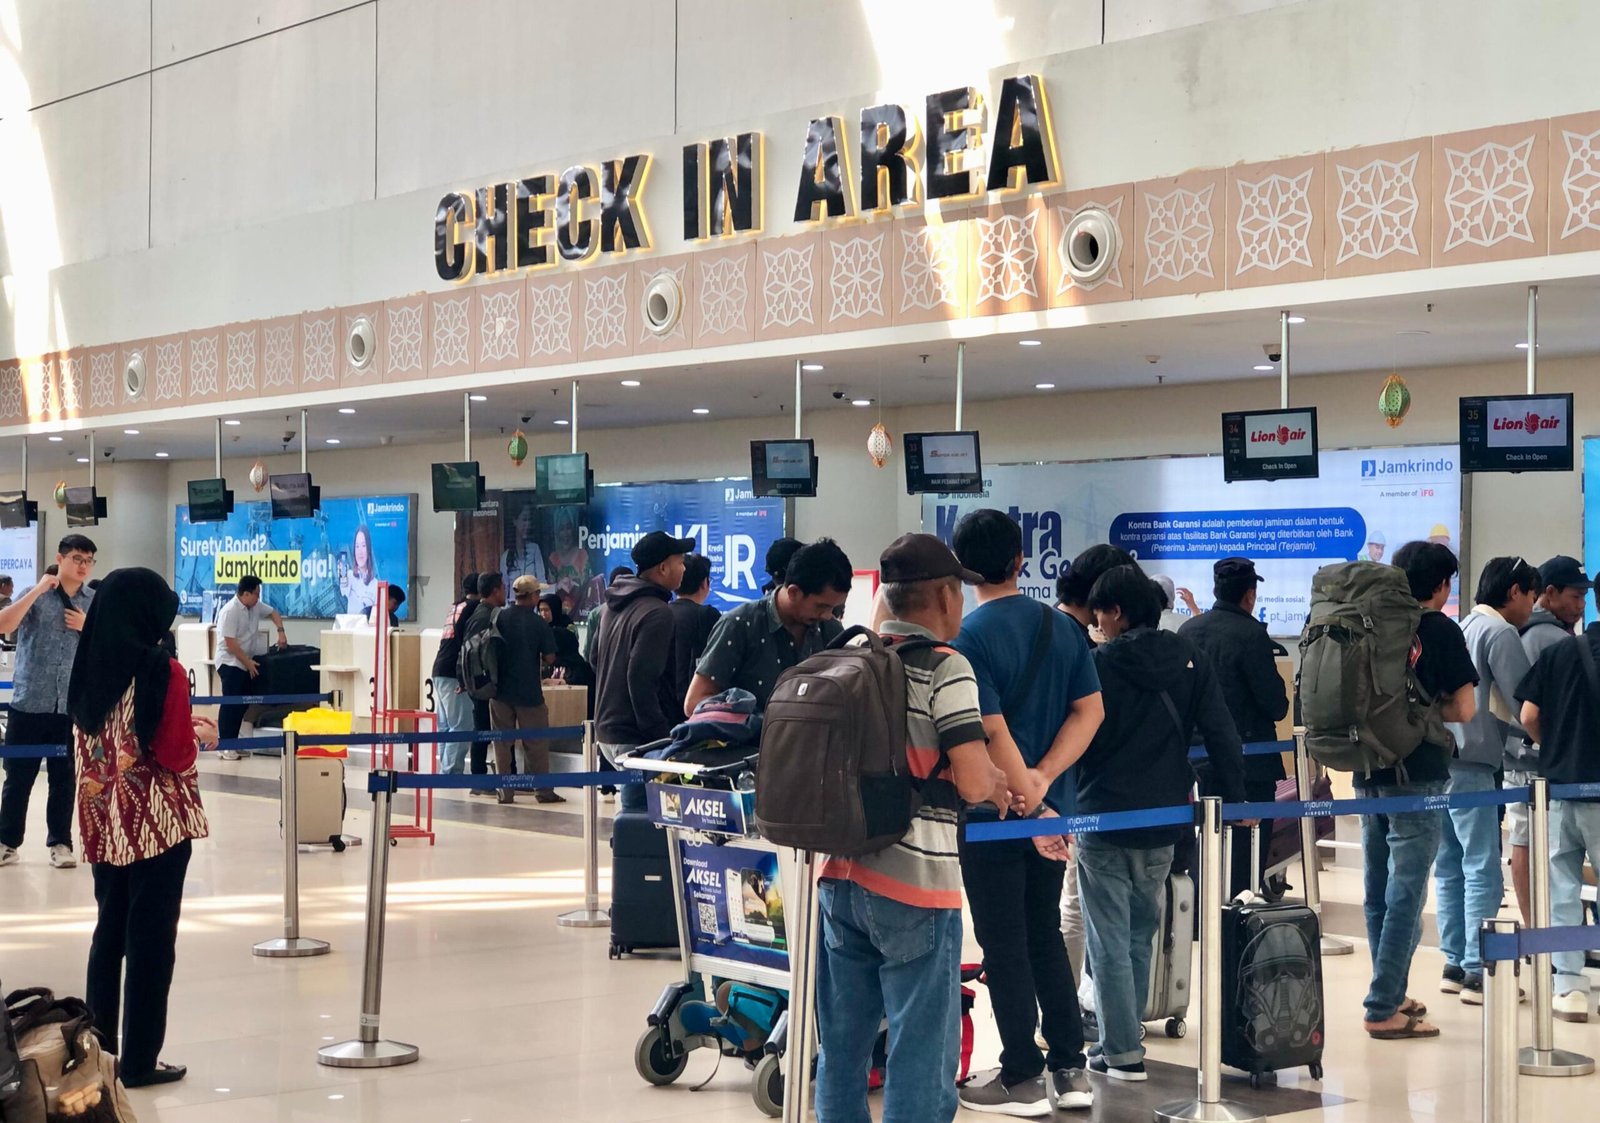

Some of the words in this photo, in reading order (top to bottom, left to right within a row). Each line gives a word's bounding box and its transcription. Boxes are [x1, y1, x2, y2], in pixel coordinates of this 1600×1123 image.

[434, 153, 652, 283] CHECK
[682, 132, 764, 241] IN
[793, 73, 1062, 223] AREA
[1467, 409, 1479, 420] 35
[1228, 424, 1239, 434] 34
[1493, 417, 1524, 431] Lion
[1540, 415, 1560, 429] air
[1250, 430, 1276, 443] Lion
[1289, 427, 1306, 441] air
[1505, 453, 1524, 461] Check
[1525, 453, 1532, 461] In
[1532, 453, 1548, 462] Open
[1379, 458, 1454, 474] Jamkrindo
[1385, 490, 1410, 498] member
[1128, 520, 1152, 530] Kontra
[1152, 520, 1171, 529] Bank
[1172, 519, 1201, 529] Garansi
[1202, 519, 1226, 528] adalah
[1226, 517, 1264, 530] pemberian
[1264, 517, 1294, 529] jaminan
[1295, 517, 1318, 526] dalam
[1319, 516, 1345, 526] bentuk
[936, 504, 1062, 558] Ktra
[1120, 533, 1140, 541] kontra
[1141, 532, 1166, 543] garansi
[1167, 532, 1181, 541] atas
[1182, 531, 1208, 541] fasilitas
[1209, 530, 1228, 540] Bank
[1229, 529, 1257, 540] Garansi
[1257, 530, 1276, 541] yang
[1277, 529, 1315, 539] diterbitkan
[1316, 529, 1333, 538] oleh
[1334, 528, 1354, 538] Bank
[180, 536, 222, 557] Surety
[224, 533, 267, 553] Bond?
[1151, 543, 1185, 554] (Penerima
[1186, 542, 1218, 554] Jaminan)
[1219, 542, 1245, 553] kepada
[1246, 541, 1277, 553] Principal
[1278, 540, 1317, 552] (Terjamin).
[216, 553, 298, 578] Jamkrindo
[301, 551, 333, 586] aja!
[1264, 595, 1285, 603] media
[684, 797, 727, 819] AKSEL
[1303, 801, 1333, 811] injourney
[1066, 815, 1100, 828] injourney
[683, 857, 708, 868] Download
[686, 867, 722, 888] AKSEL
[693, 890, 716, 903] Sekarang
